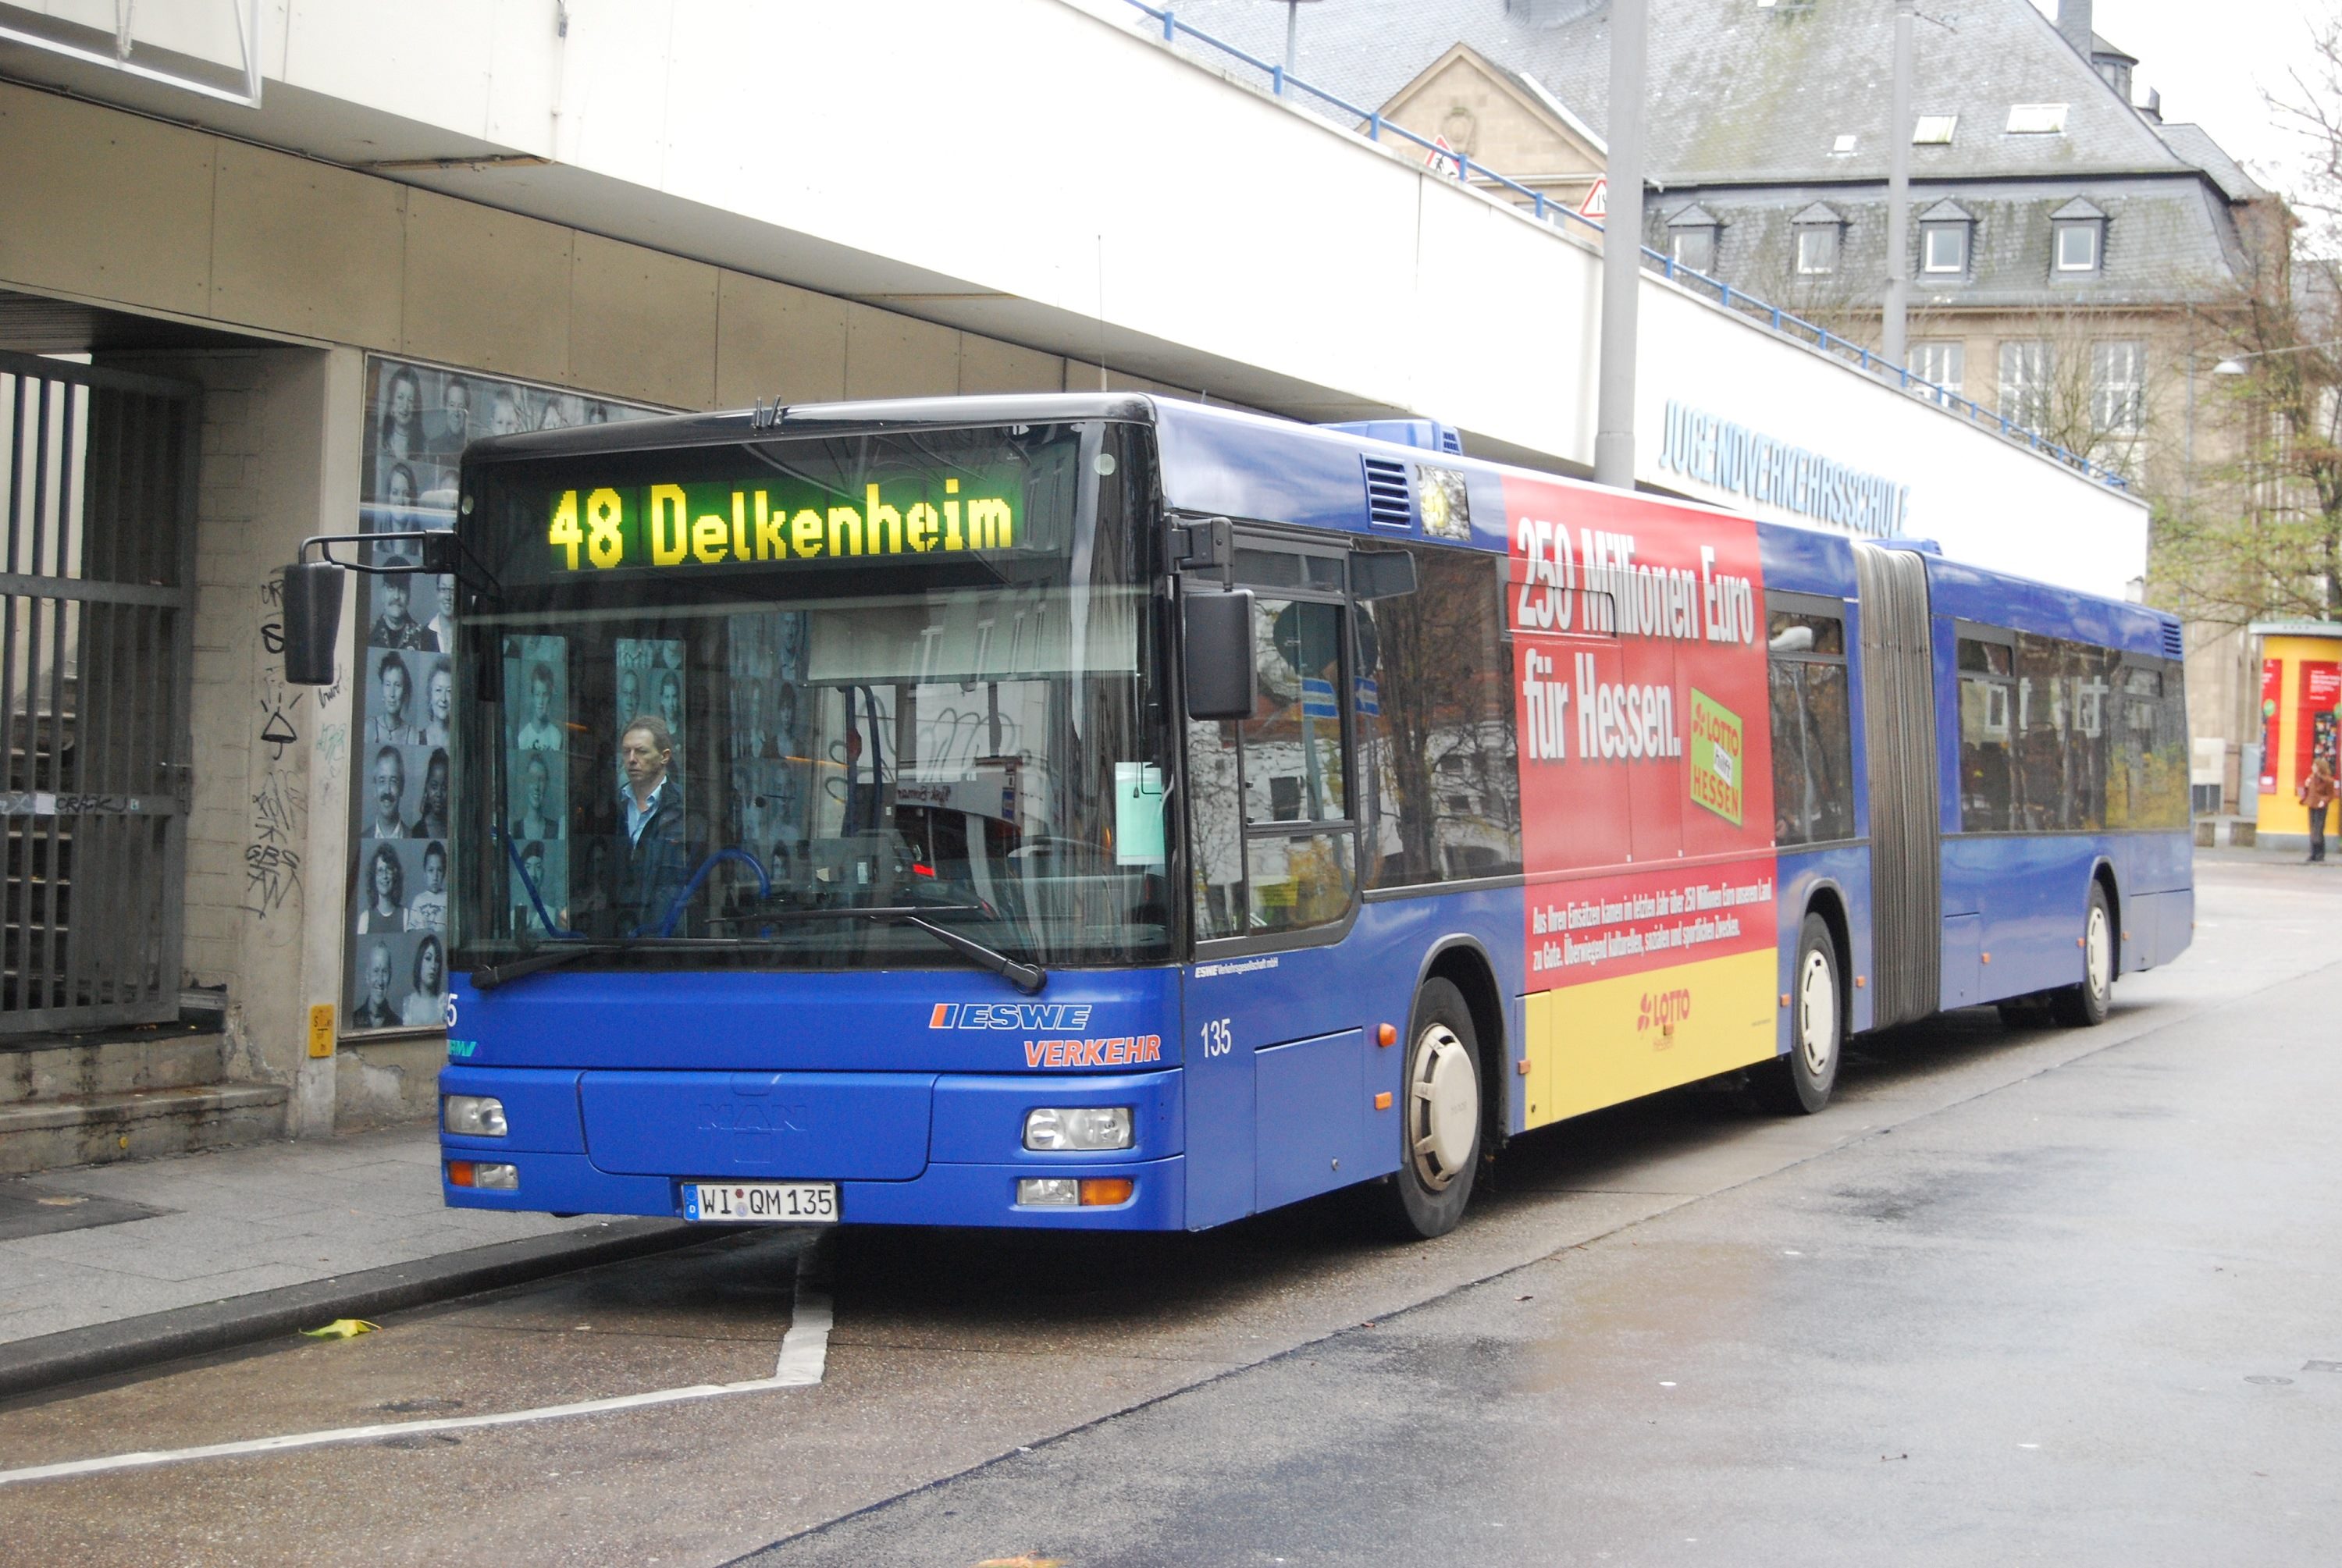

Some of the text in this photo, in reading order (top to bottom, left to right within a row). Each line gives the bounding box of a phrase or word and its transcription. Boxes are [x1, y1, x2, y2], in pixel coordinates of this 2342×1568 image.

[1659, 397, 1911, 539] JUGENDVERKEHRSSCHULE
[550, 478, 1012, 571] 48 Delkenheim
[1517, 517, 1754, 645] 250 Millionen Euro
[1522, 648, 1682, 760] für Hessen.
[1707, 711, 1739, 757] LOTTO
[1693, 764, 1739, 819] HESSEN
[1194, 965, 1218, 979] ESWE
[958, 1004, 1093, 1031] ESWE
[1653, 987, 1690, 1026] LOTTO
[1023, 1034, 1162, 1068] VERKEHR
[1201, 1018, 1232, 1058] 135
[698, 1104, 809, 1132] MAN
[701, 1189, 833, 1215] WI QM 135
